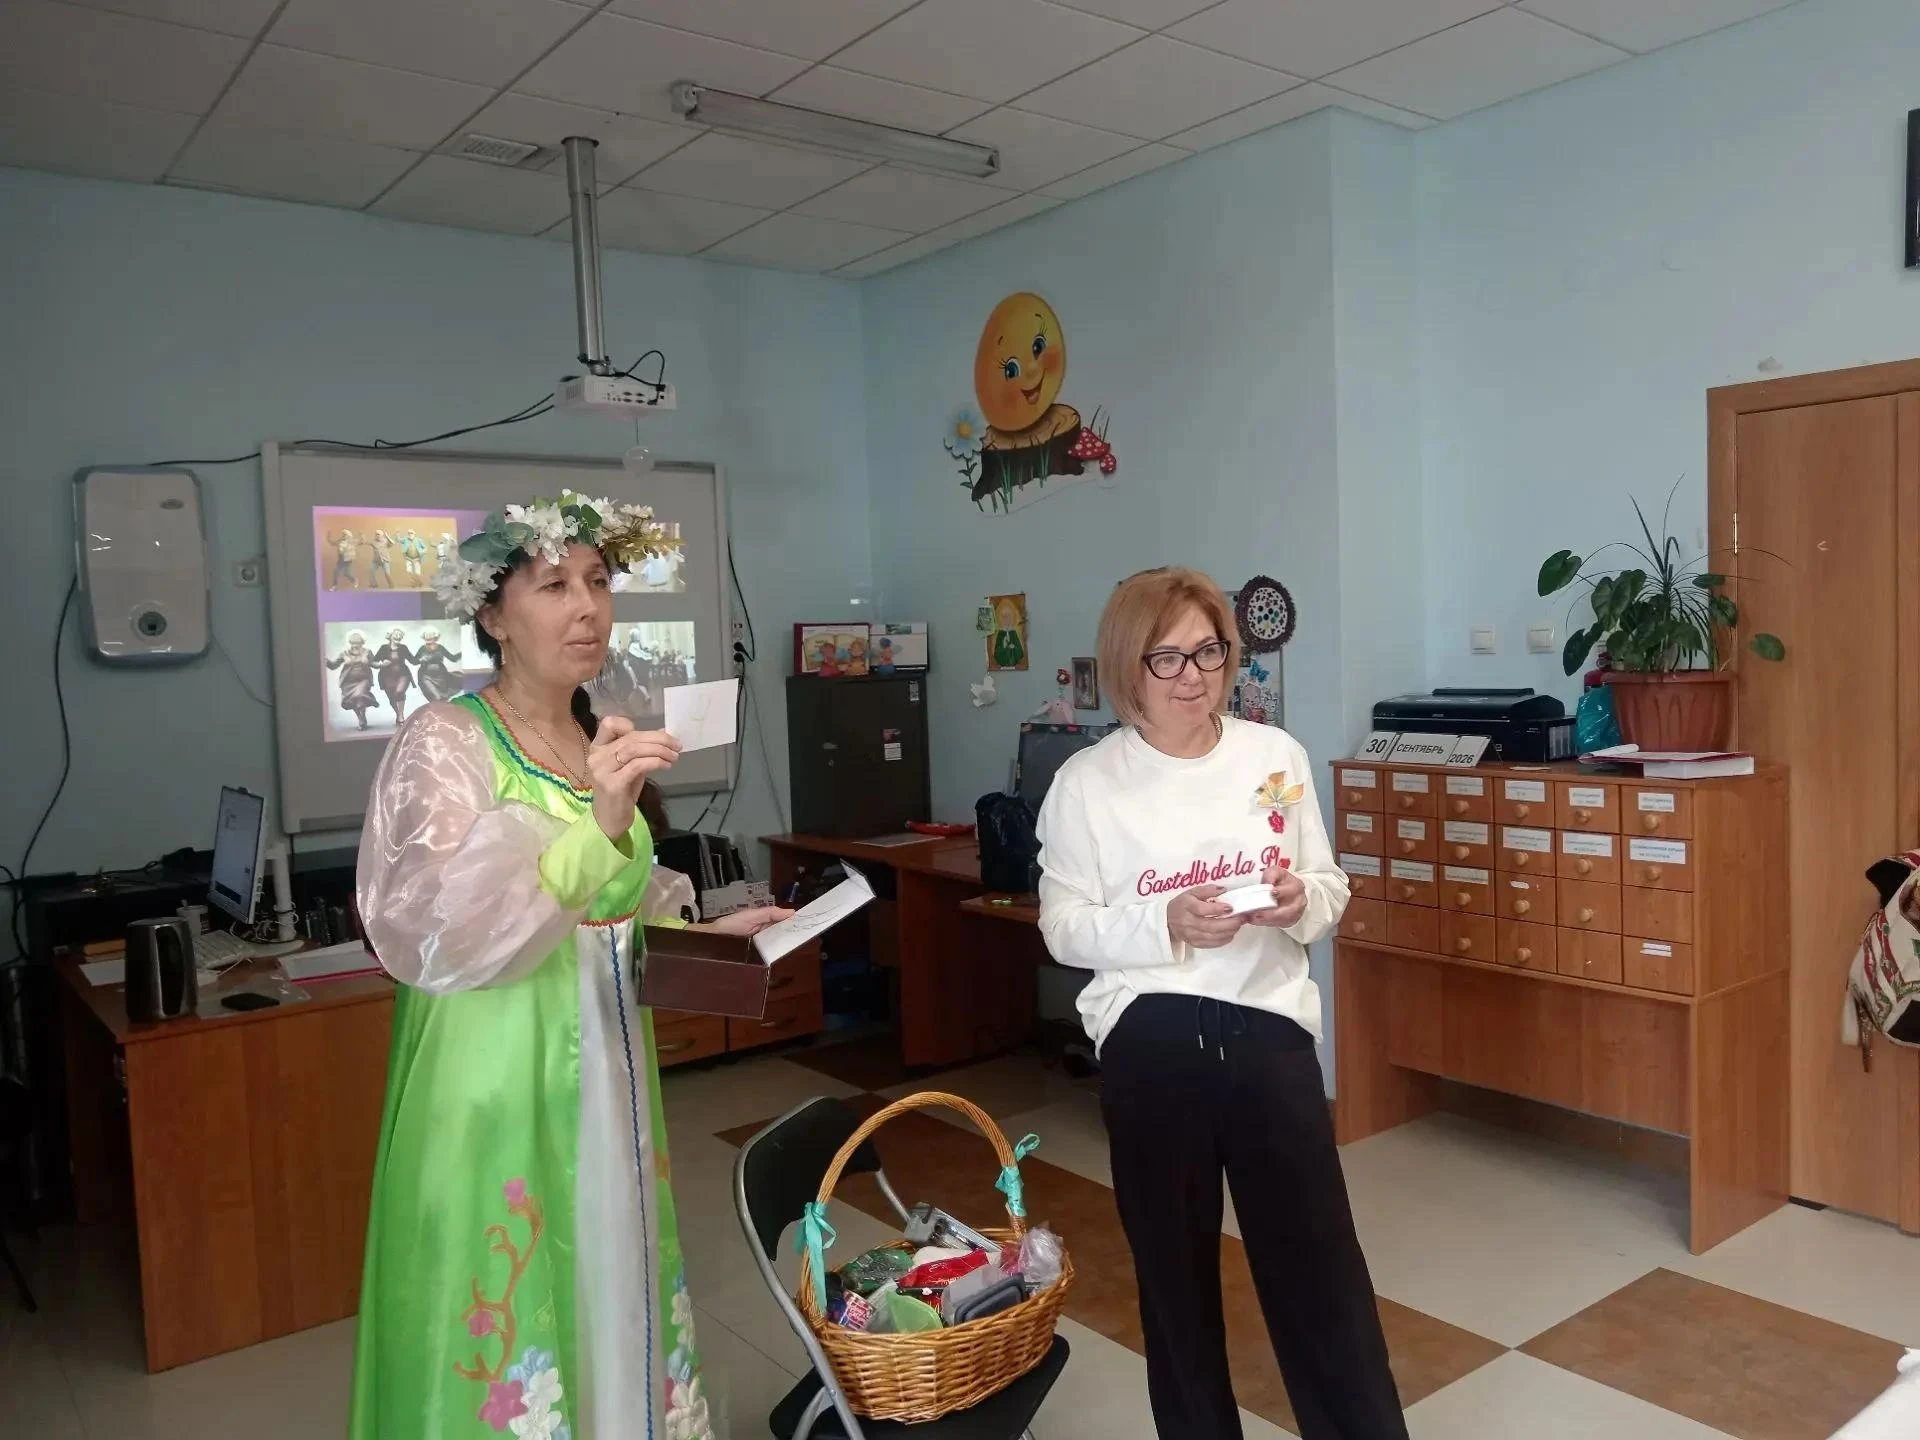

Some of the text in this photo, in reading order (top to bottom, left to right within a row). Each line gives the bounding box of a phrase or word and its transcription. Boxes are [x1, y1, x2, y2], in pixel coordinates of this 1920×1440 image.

[1366, 738, 1475, 764] 30 СЕНТЯБРЬ 2026
[1211, 854, 1234, 881] de
[1234, 850, 1256, 876] la
